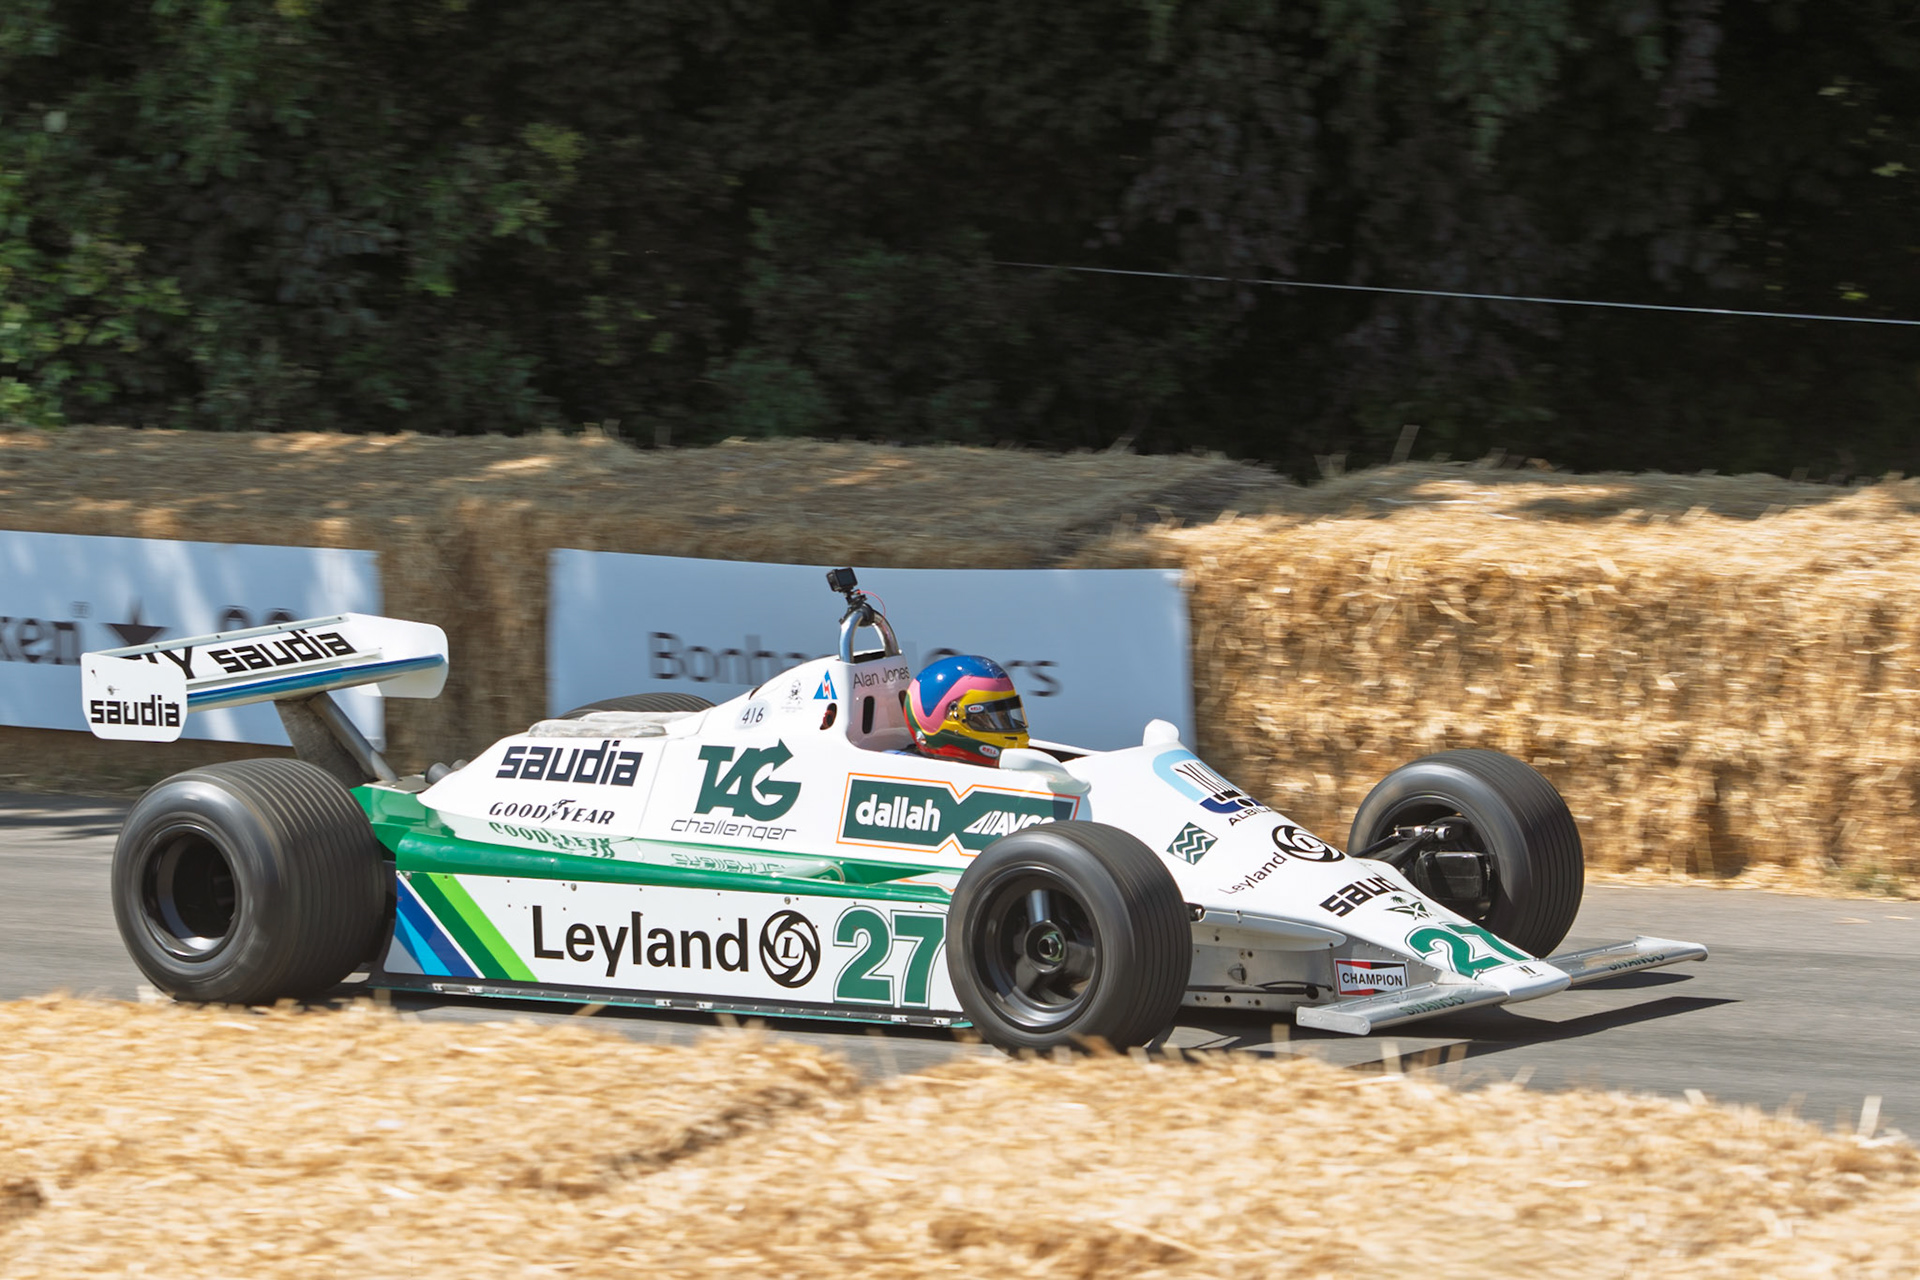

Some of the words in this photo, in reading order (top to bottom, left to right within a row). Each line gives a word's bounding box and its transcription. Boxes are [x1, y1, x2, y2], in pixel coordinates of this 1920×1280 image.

[207, 629, 358, 673] saudia
[853, 671, 880, 690] Alan
[882, 666, 910, 684] Jones
[90, 694, 180, 727] saudia
[742, 706, 765, 724] 416
[495, 740, 644, 787] saudia
[693, 738, 802, 822] TAG
[488, 799, 616, 825] GOODYEAR
[670, 818, 797, 841] challenger
[855, 793, 941, 832] dallah
[1218, 851, 1288, 895] Leyland
[532, 905, 749, 978] Leyland
[832, 904, 948, 1008] 27
[1342, 972, 1403, 987] CHAMPION
